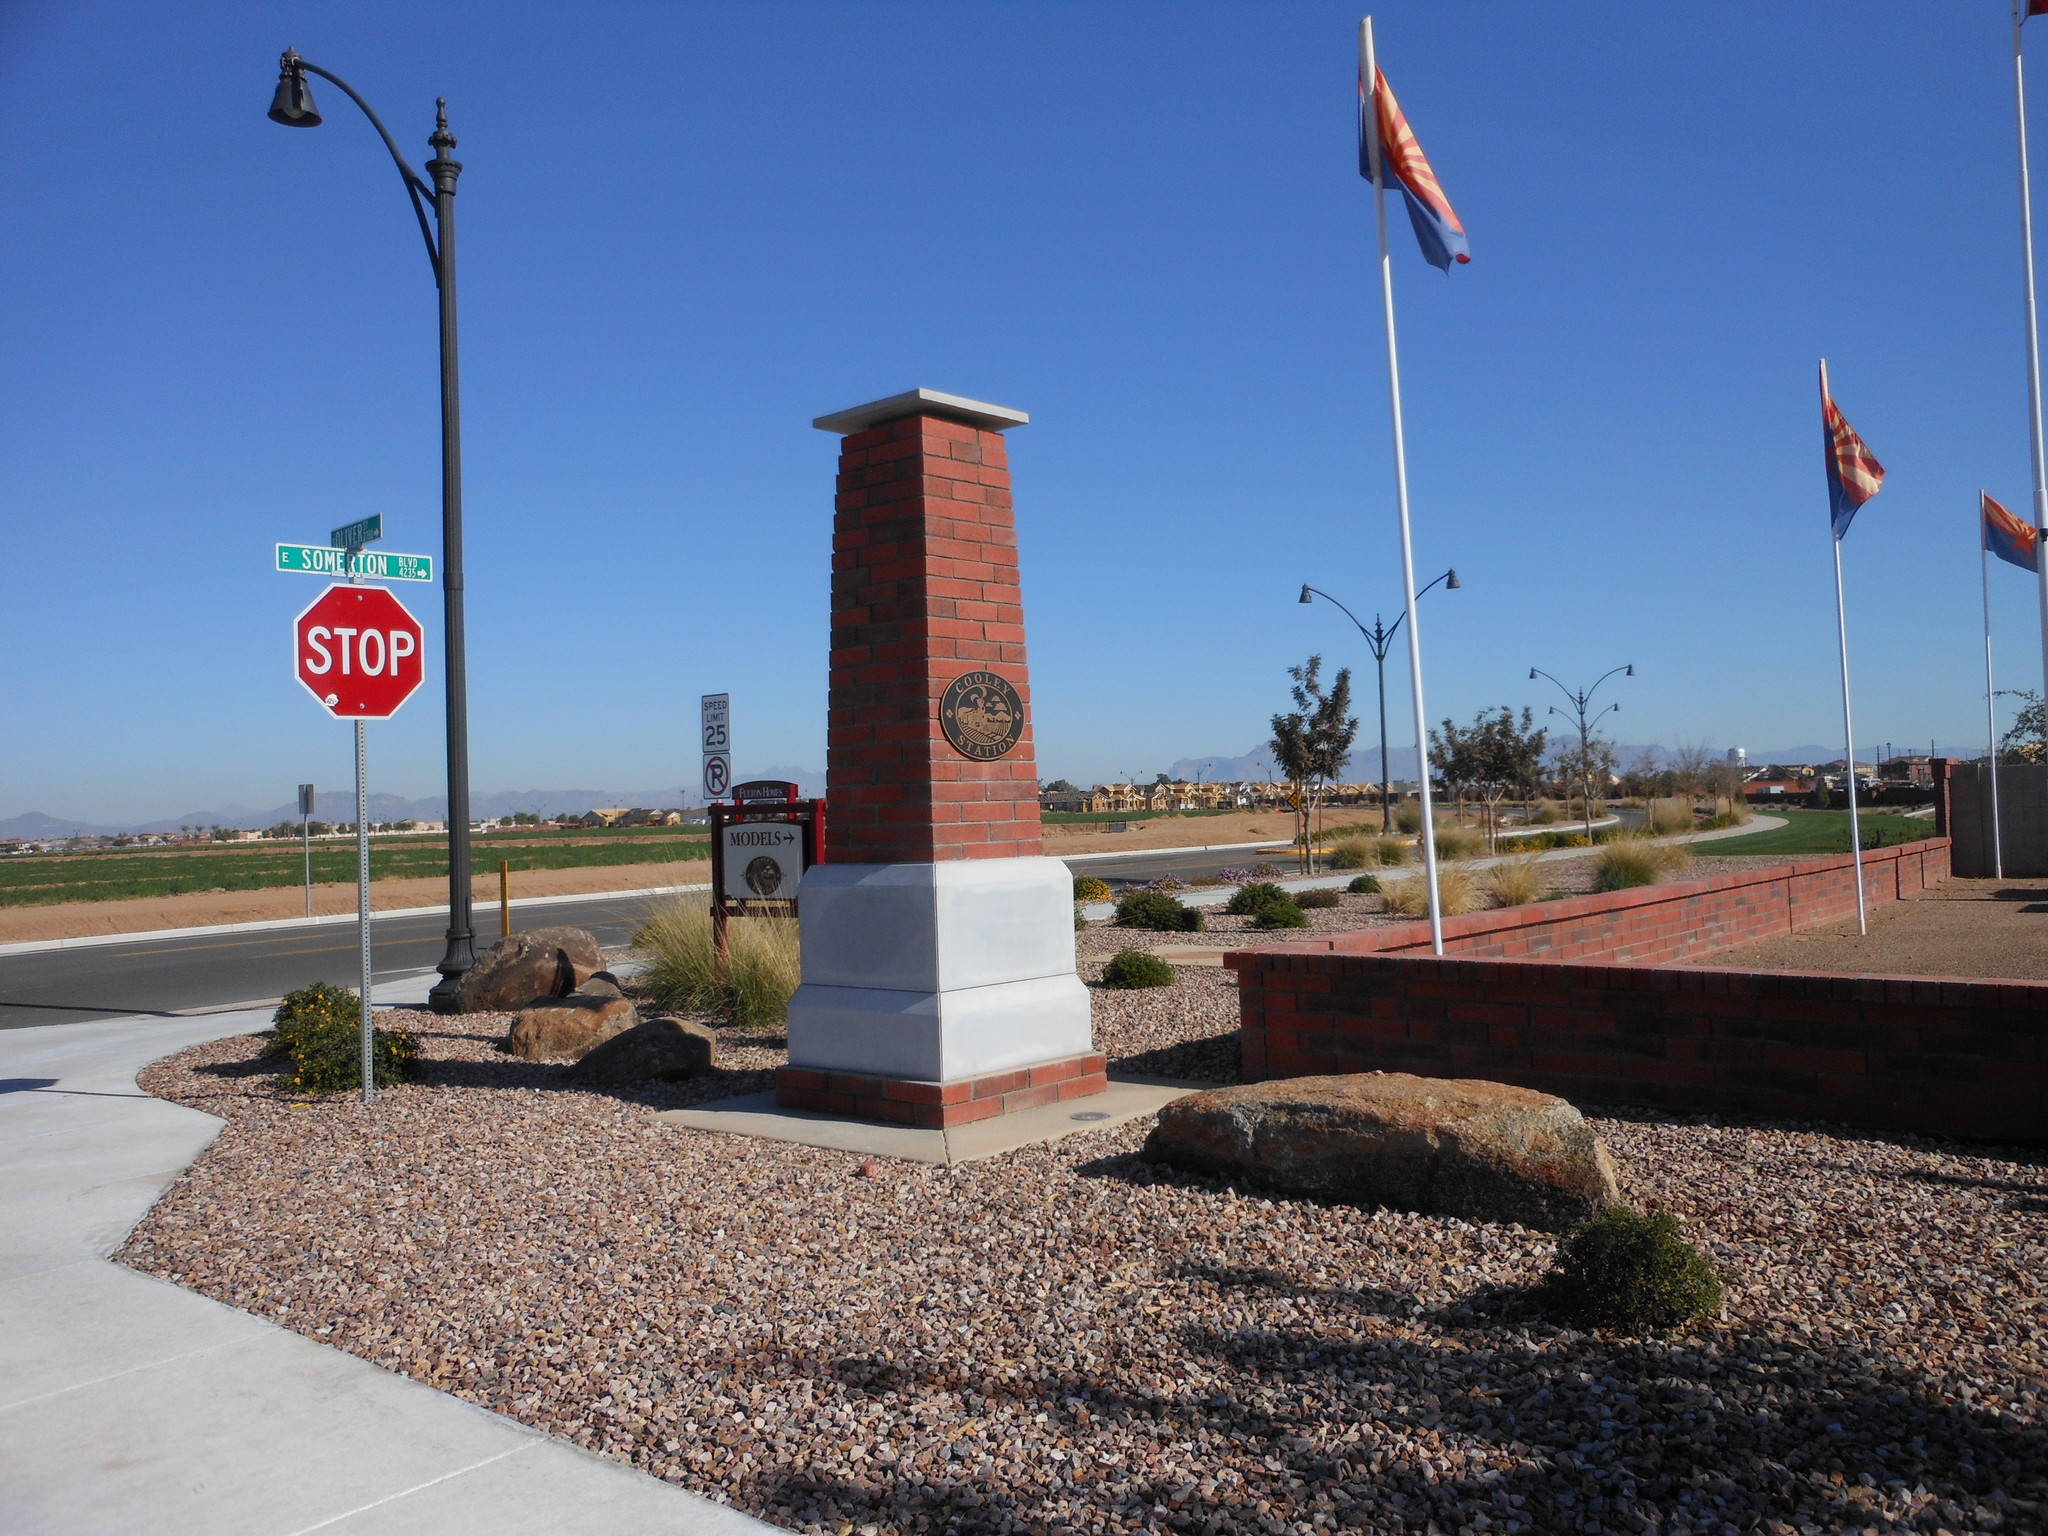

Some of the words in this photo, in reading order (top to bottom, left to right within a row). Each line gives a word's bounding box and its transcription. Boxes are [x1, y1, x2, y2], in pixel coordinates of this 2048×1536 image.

[335, 523, 362, 548] OLIVER
[281, 552, 289, 563] E
[301, 549, 388, 575] SOMERTON
[398, 557, 418, 568] BLVD
[398, 567, 417, 578] 4235
[305, 625, 416, 677] STOP
[955, 673, 1011, 694] COOLEY
[703, 700, 727, 711] SPEED
[706, 712, 724, 723] LIMIT
[705, 724, 726, 746] 25
[957, 734, 1016, 757] STATION
[730, 831, 782, 847] MODELS
